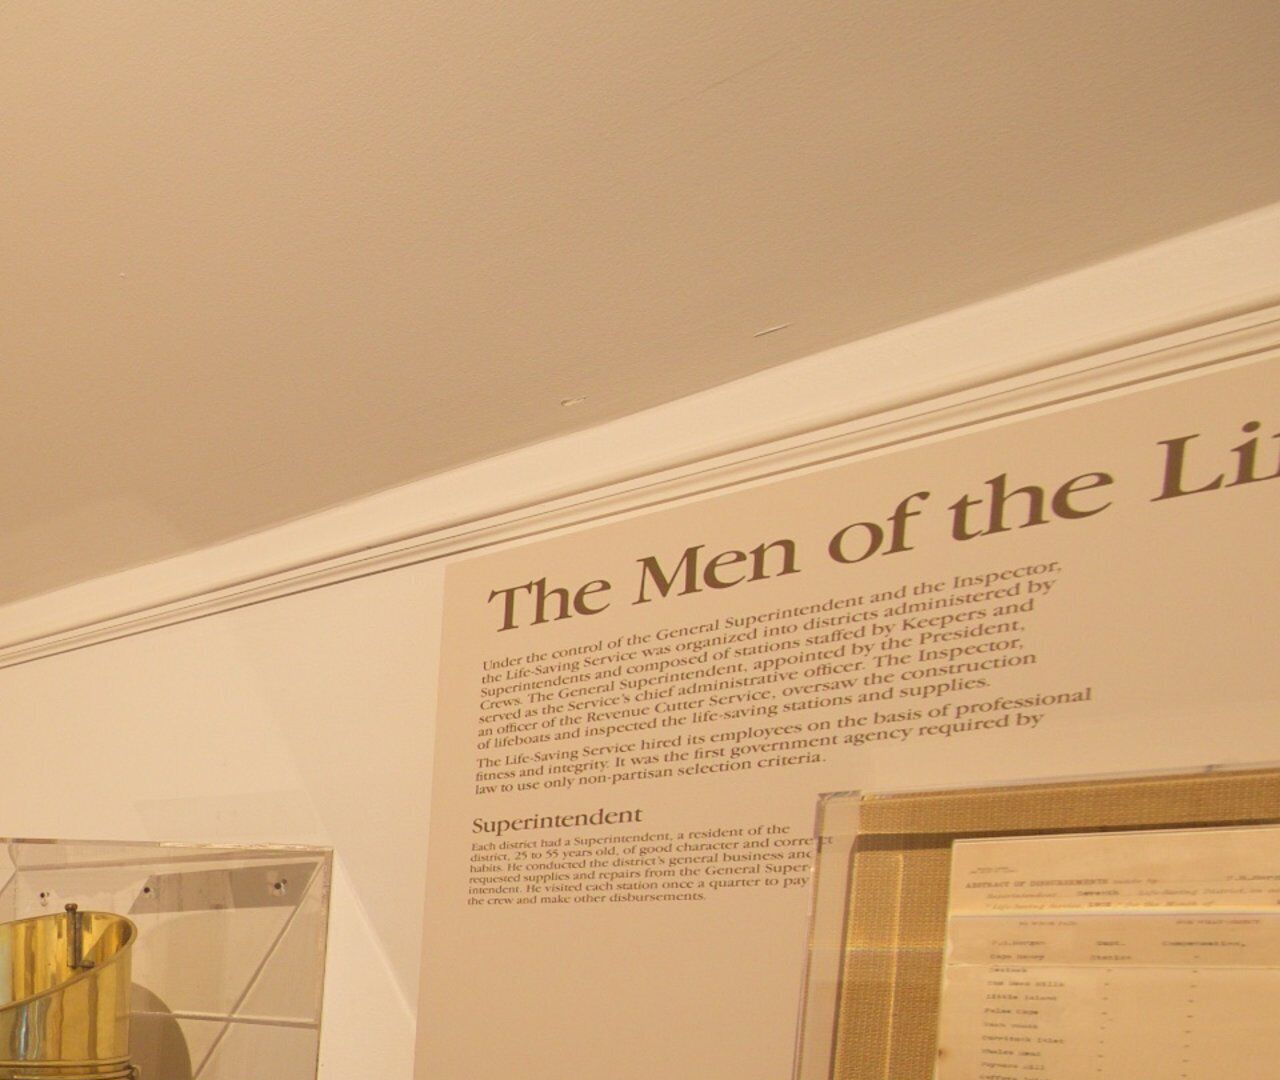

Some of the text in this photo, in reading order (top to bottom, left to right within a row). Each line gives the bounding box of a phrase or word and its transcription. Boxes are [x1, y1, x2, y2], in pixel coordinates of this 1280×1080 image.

[489, 421, 1280, 633] The Men of the Li
[480, 598, 1034, 698] Superintendents and composed of stations staffed by Keepers and
[481, 579, 1055, 685] the Life-Saving Service was organized into districts administered by
[482, 657, 522, 671] Under
[526, 651, 547, 664] the
[551, 640, 602, 659] control
[607, 636, 622, 649] of
[626, 633, 651, 646] the
[655, 619, 719, 641] General
[724, 594, 863, 629] Superintendent
[869, 585, 906, 603] and
[912, 580, 945, 596] the
[478, 708, 522, 724] served
[524, 708, 539, 717] as
[542, 703, 563, 715] the
[567, 693, 631, 711] Service's
[634, 686, 674, 702] chief
[677, 670, 798, 696] administrative
[876, 652, 911, 668] The
[478, 728, 493, 737] an
[496, 721, 538, 735] officer
[541, 716, 556, 729] of
[559, 714, 582, 726] the
[586, 706, 650, 722] Revenue
[654, 699, 704, 714] Cutter
[782, 678, 858, 697] oversaw
[863, 671, 894, 686] the
[900, 654, 1036, 681] construction
[527, 691, 554, 704] The
[557, 680, 615, 699] General
[753, 645, 845, 672] appointed
[851, 642, 874, 657] by
[880, 636, 912, 651] the
[475, 770, 516, 782] fitness
[519, 764, 544, 777] and
[615, 757, 625, 767] It
[630, 755, 659, 766] was
[663, 750, 689, 762] the
[694, 746, 724, 759] first
[730, 734, 838, 759] government
[843, 728, 912, 746] agency
[918, 714, 1009, 738] required
[1016, 712, 1044, 728] by
[476, 738, 491, 750] of
[494, 733, 551, 748] lifeboats
[554, 727, 580, 741] and
[584, 717, 657, 737] inspected
[661, 714, 686, 727] the
[692, 704, 778, 724] life-saving
[782, 695, 852, 712] stations
[857, 686, 894, 703] and
[476, 687, 1092, 769] The Life-Saving Service hired its employees on the basis of professional
[475, 784, 497, 795] law
[500, 783, 514, 792] to
[516, 781, 540, 791] use
[543, 776, 574, 789] only
[578, 768, 673, 785] non-partisan
[677, 760, 752, 776] selection
[472, 808, 643, 836] Superintendent
